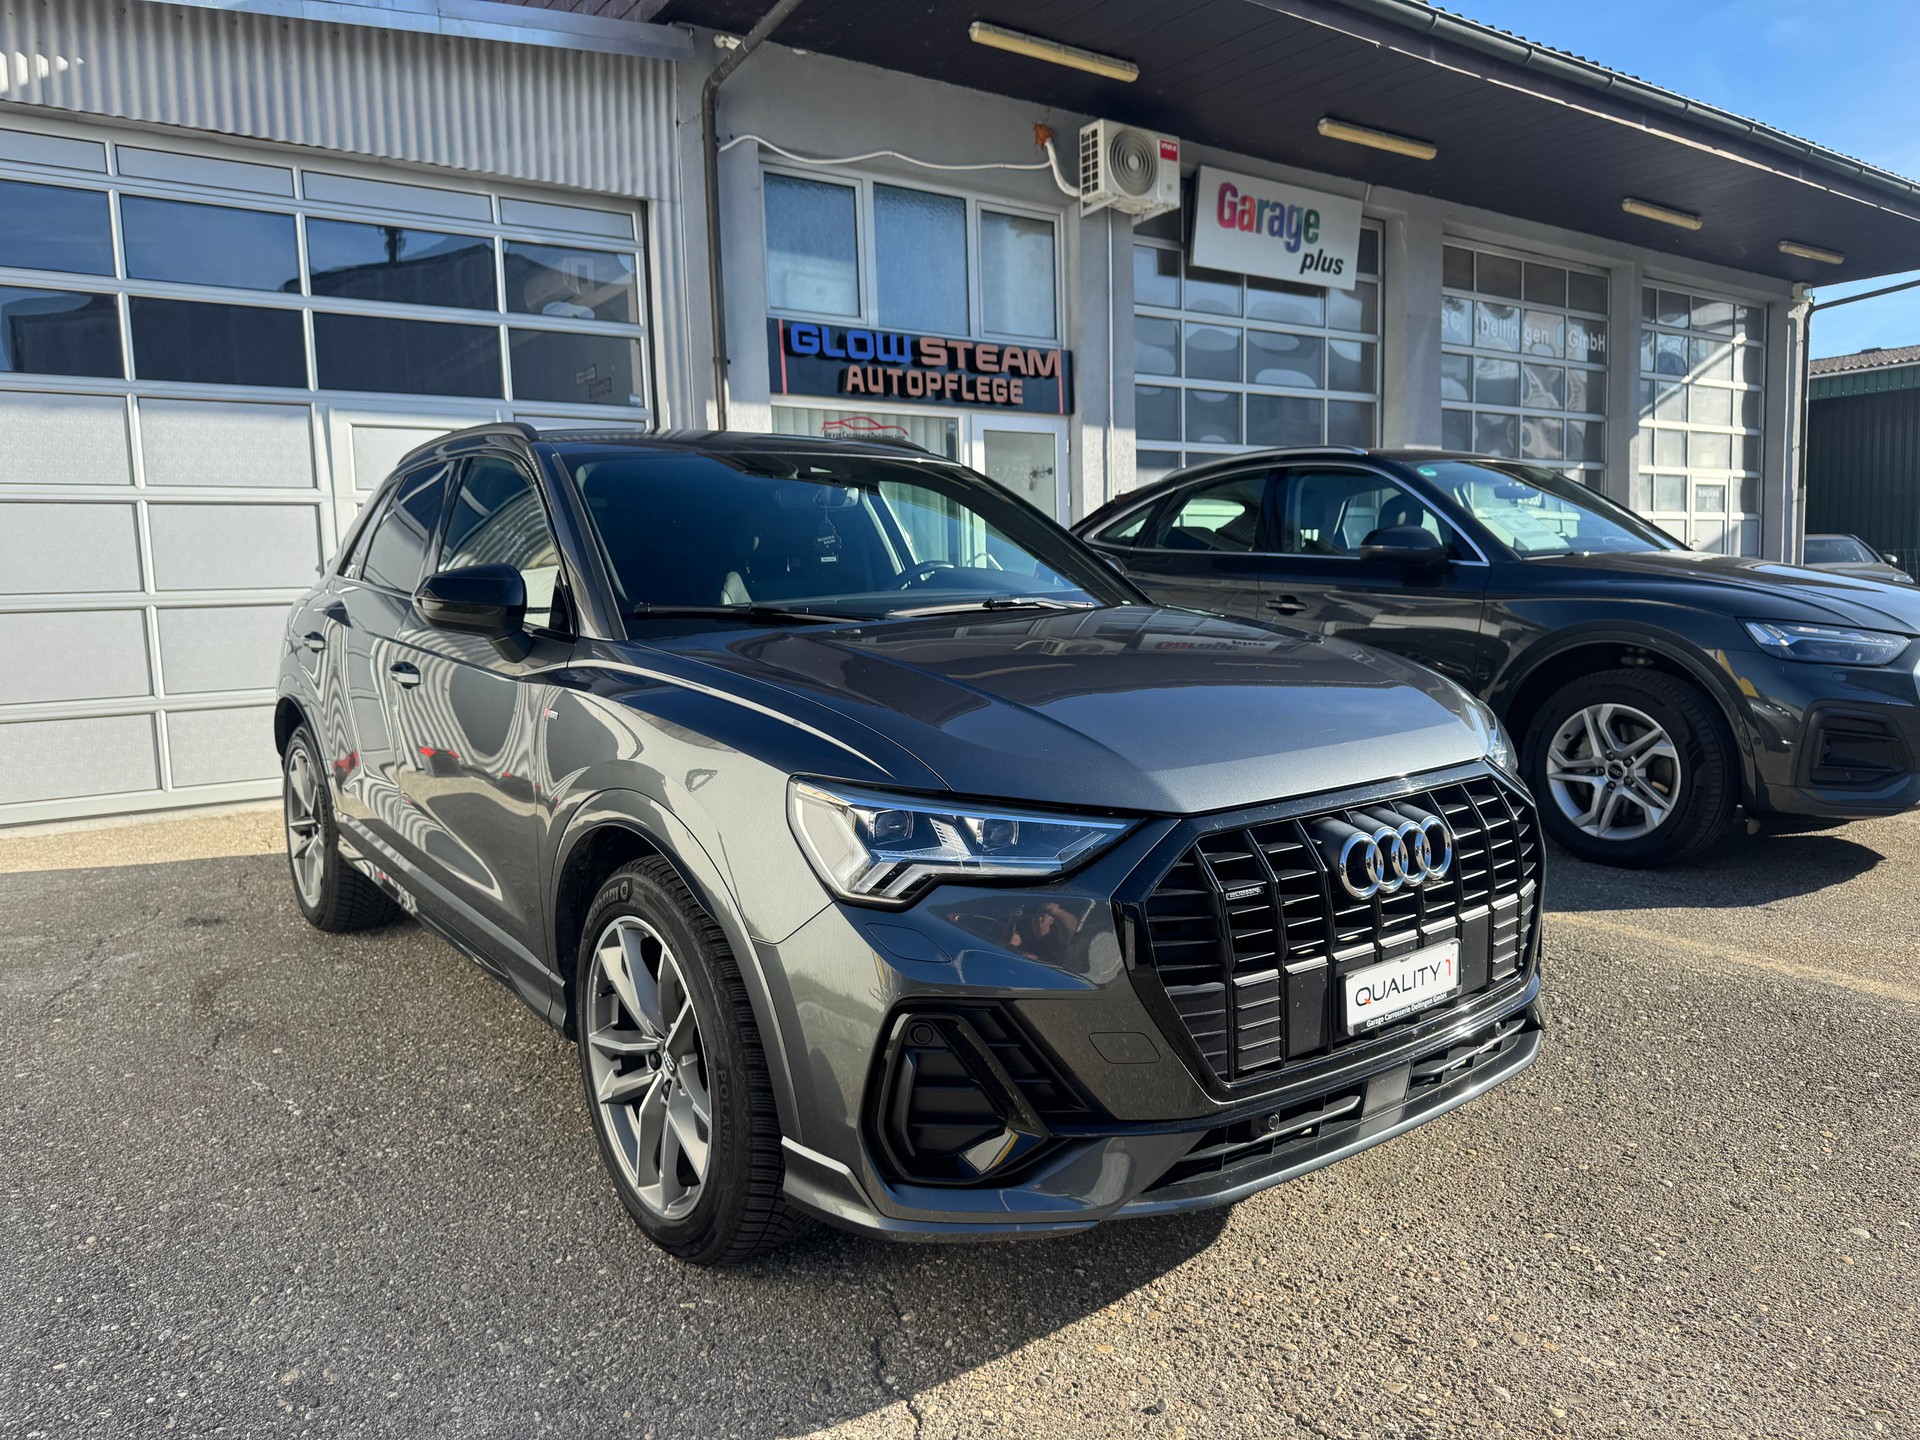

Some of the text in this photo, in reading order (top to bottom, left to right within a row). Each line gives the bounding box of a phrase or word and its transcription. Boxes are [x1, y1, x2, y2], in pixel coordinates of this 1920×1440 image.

[1216, 182, 1320, 253] Garage
[1299, 249, 1344, 275] plus
[789, 322, 1062, 377] GLOW STEAM
[1568, 330, 1606, 352] GmbH
[846, 365, 1024, 404] AUTOPFLEGE
[1355, 961, 1441, 1007] QUALITY
[1366, 1016, 1384, 1028] Garage
[717, 1069, 732, 1161] POLARIS
